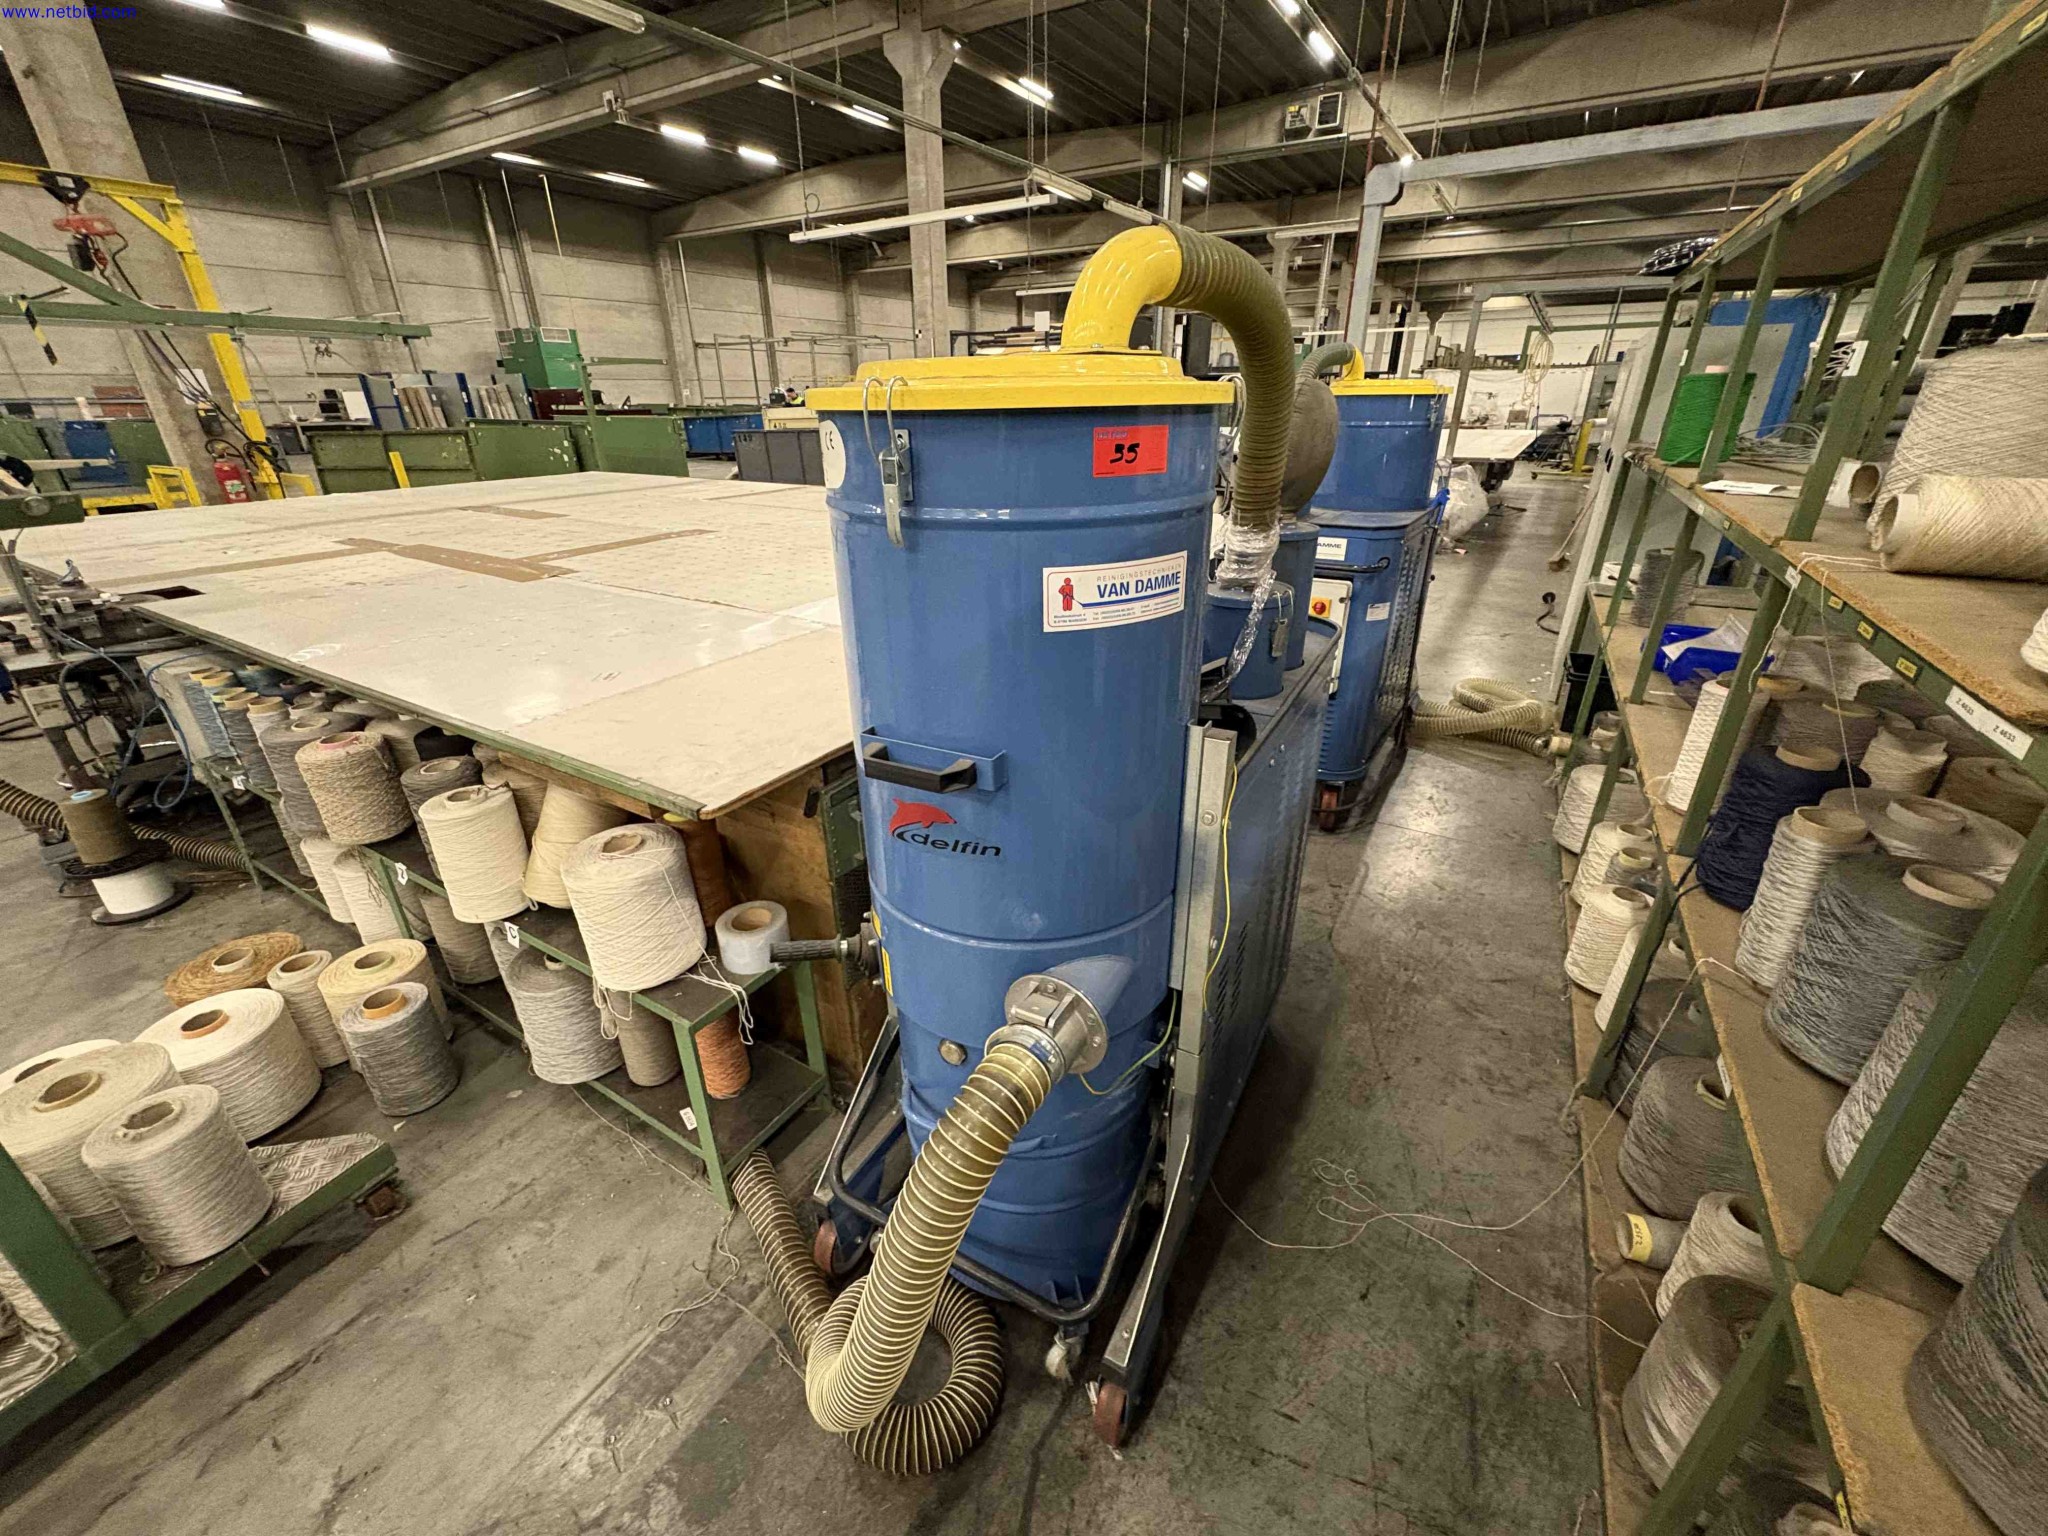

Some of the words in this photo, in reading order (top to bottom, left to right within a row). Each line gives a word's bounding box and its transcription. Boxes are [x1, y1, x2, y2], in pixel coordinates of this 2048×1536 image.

[1097, 581, 1130, 598] VAN
[1135, 571, 1182, 594] DAMME
[911, 833, 1002, 857] delfin
